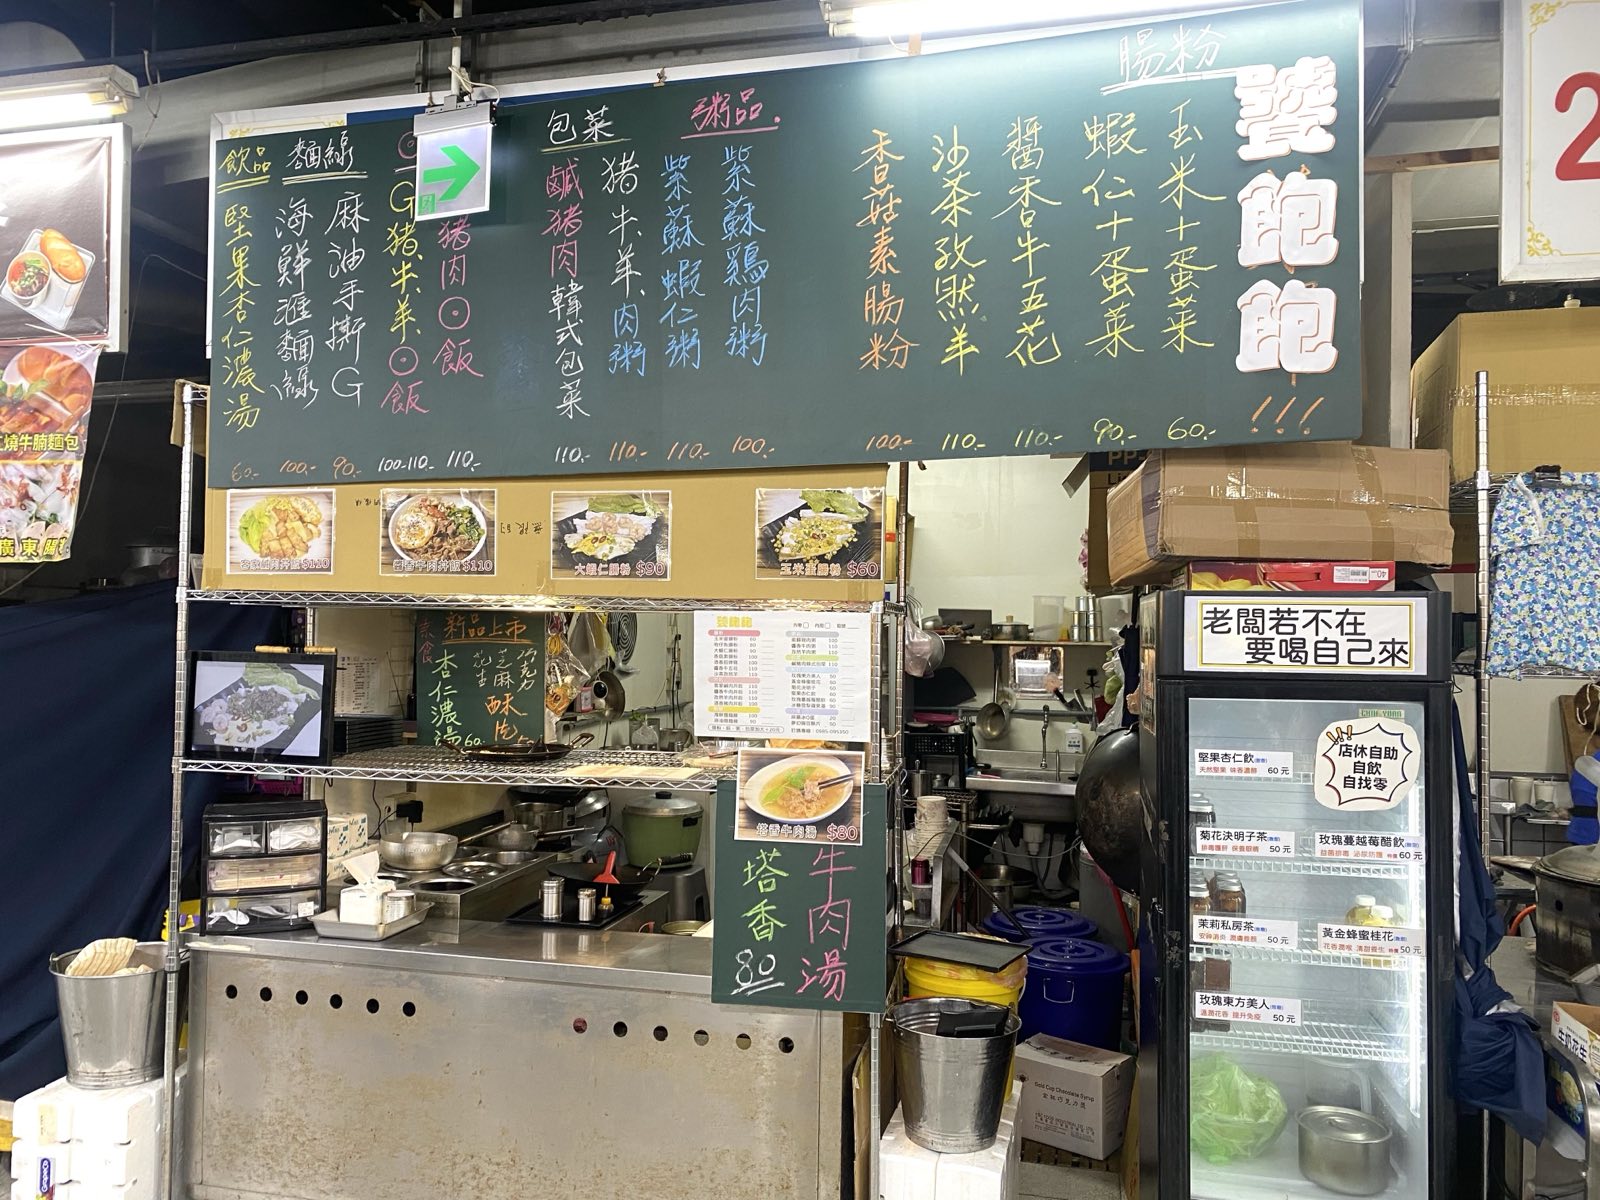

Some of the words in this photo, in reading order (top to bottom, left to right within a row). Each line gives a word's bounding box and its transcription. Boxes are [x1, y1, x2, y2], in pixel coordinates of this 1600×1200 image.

[1119, 24, 1226, 80] 腸粉
[547, 104, 615, 143] 包菜
[218, 146, 271, 175] 飲品
[852, 129, 920, 371] 香菇素腸粉
[659, 153, 705, 370] 紫蘇蝦仁粥
[0, 434, 79, 451] 燒牛腩麵包
[462, 560, 493, 572] $110
[635, 560, 665, 577] $90
[846, 561, 878, 577] $60
[444, 612, 527, 641] 新品上市
[1203, 607, 1366, 637] 老闆若不在
[1245, 637, 1410, 666] 要喝自己來
[473, 650, 492, 687] 花生
[494, 649, 515, 688] 芝麻
[1198, 752, 1255, 764] 堅果杏仁飲
[1338, 744, 1398, 761] 店休自助
[1267, 767, 1279, 775] 60
[1281, 766, 1290, 775] 元
[1353, 761, 1382, 775] 自飲
[1343, 775, 1388, 791] 自找零
[756, 823, 817, 839] 塔香牛肉湯
[827, 823, 858, 841] $80
[1199, 830, 1268, 842] 菊花決明子茶
[1269, 845, 1281, 853] 50
[1283, 845, 1292, 854] 元
[1318, 834, 1405, 848] 玫瑰蔓越莓醋飲
[1399, 851, 1411, 860] 60
[1413, 851, 1424, 861] 元
[742, 848, 789, 942] 塔香
[796, 845, 856, 1001] 牛肉湯
[1198, 918, 1255, 933] 茉莉私房茶
[1267, 936, 1279, 944] 50
[1280, 936, 1290, 945] 元
[1322, 927, 1394, 942] 黃金蜂蜜桂花
[1400, 945, 1411, 954] 50
[1413, 946, 1422, 955] 元
[735, 949, 776, 986] 80
[1199, 994, 1270, 1010] 玫瑰東方美人
[1272, 1014, 1285, 1023] 50
[1286, 1014, 1296, 1024] 元
